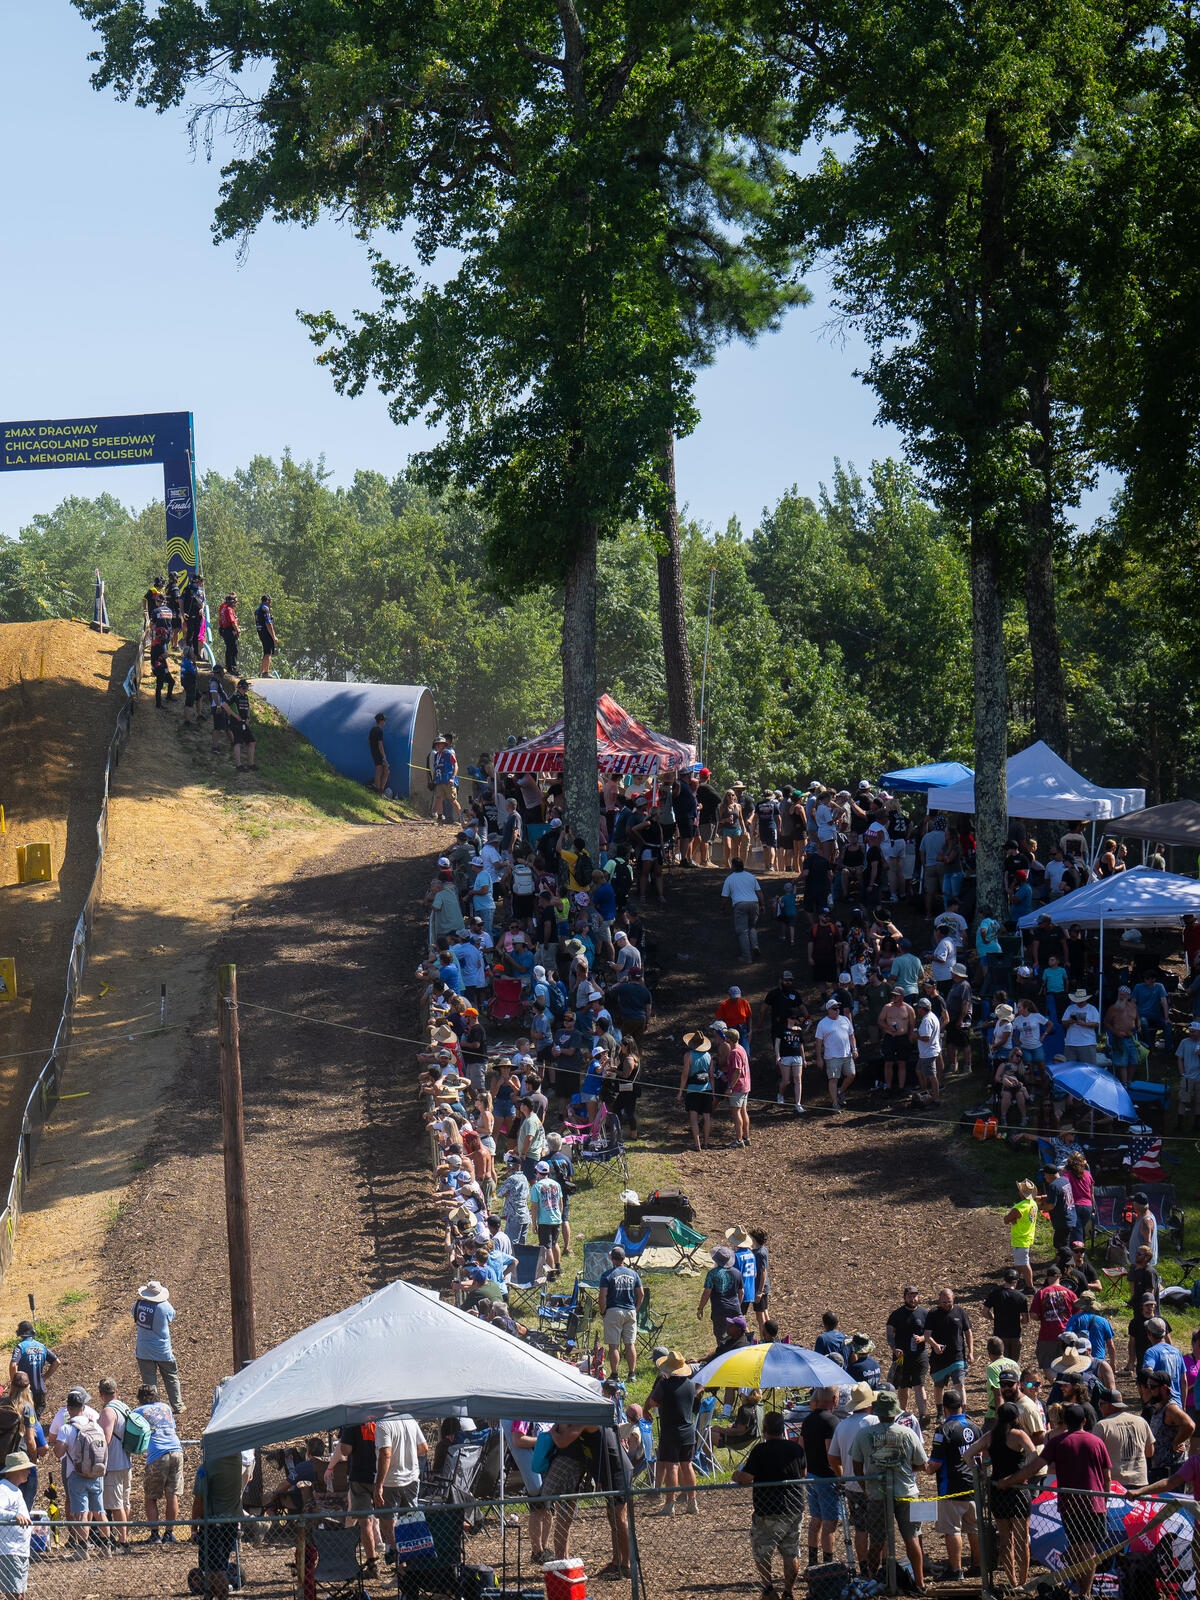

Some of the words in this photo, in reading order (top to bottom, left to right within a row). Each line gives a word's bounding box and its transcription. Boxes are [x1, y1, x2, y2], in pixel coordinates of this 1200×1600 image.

[4, 427, 36, 438] zMAX
[39, 425, 98, 436] DRAGWAY
[5, 439, 90, 451] CHICAGOLAND
[91, 434, 156, 447] SPEEDWAY
[5, 455, 27, 465] L.A.
[30, 451, 92, 463] MEMORIAL
[94, 448, 153, 460] COLISEUM
[138, 1311, 146, 1322] 6
